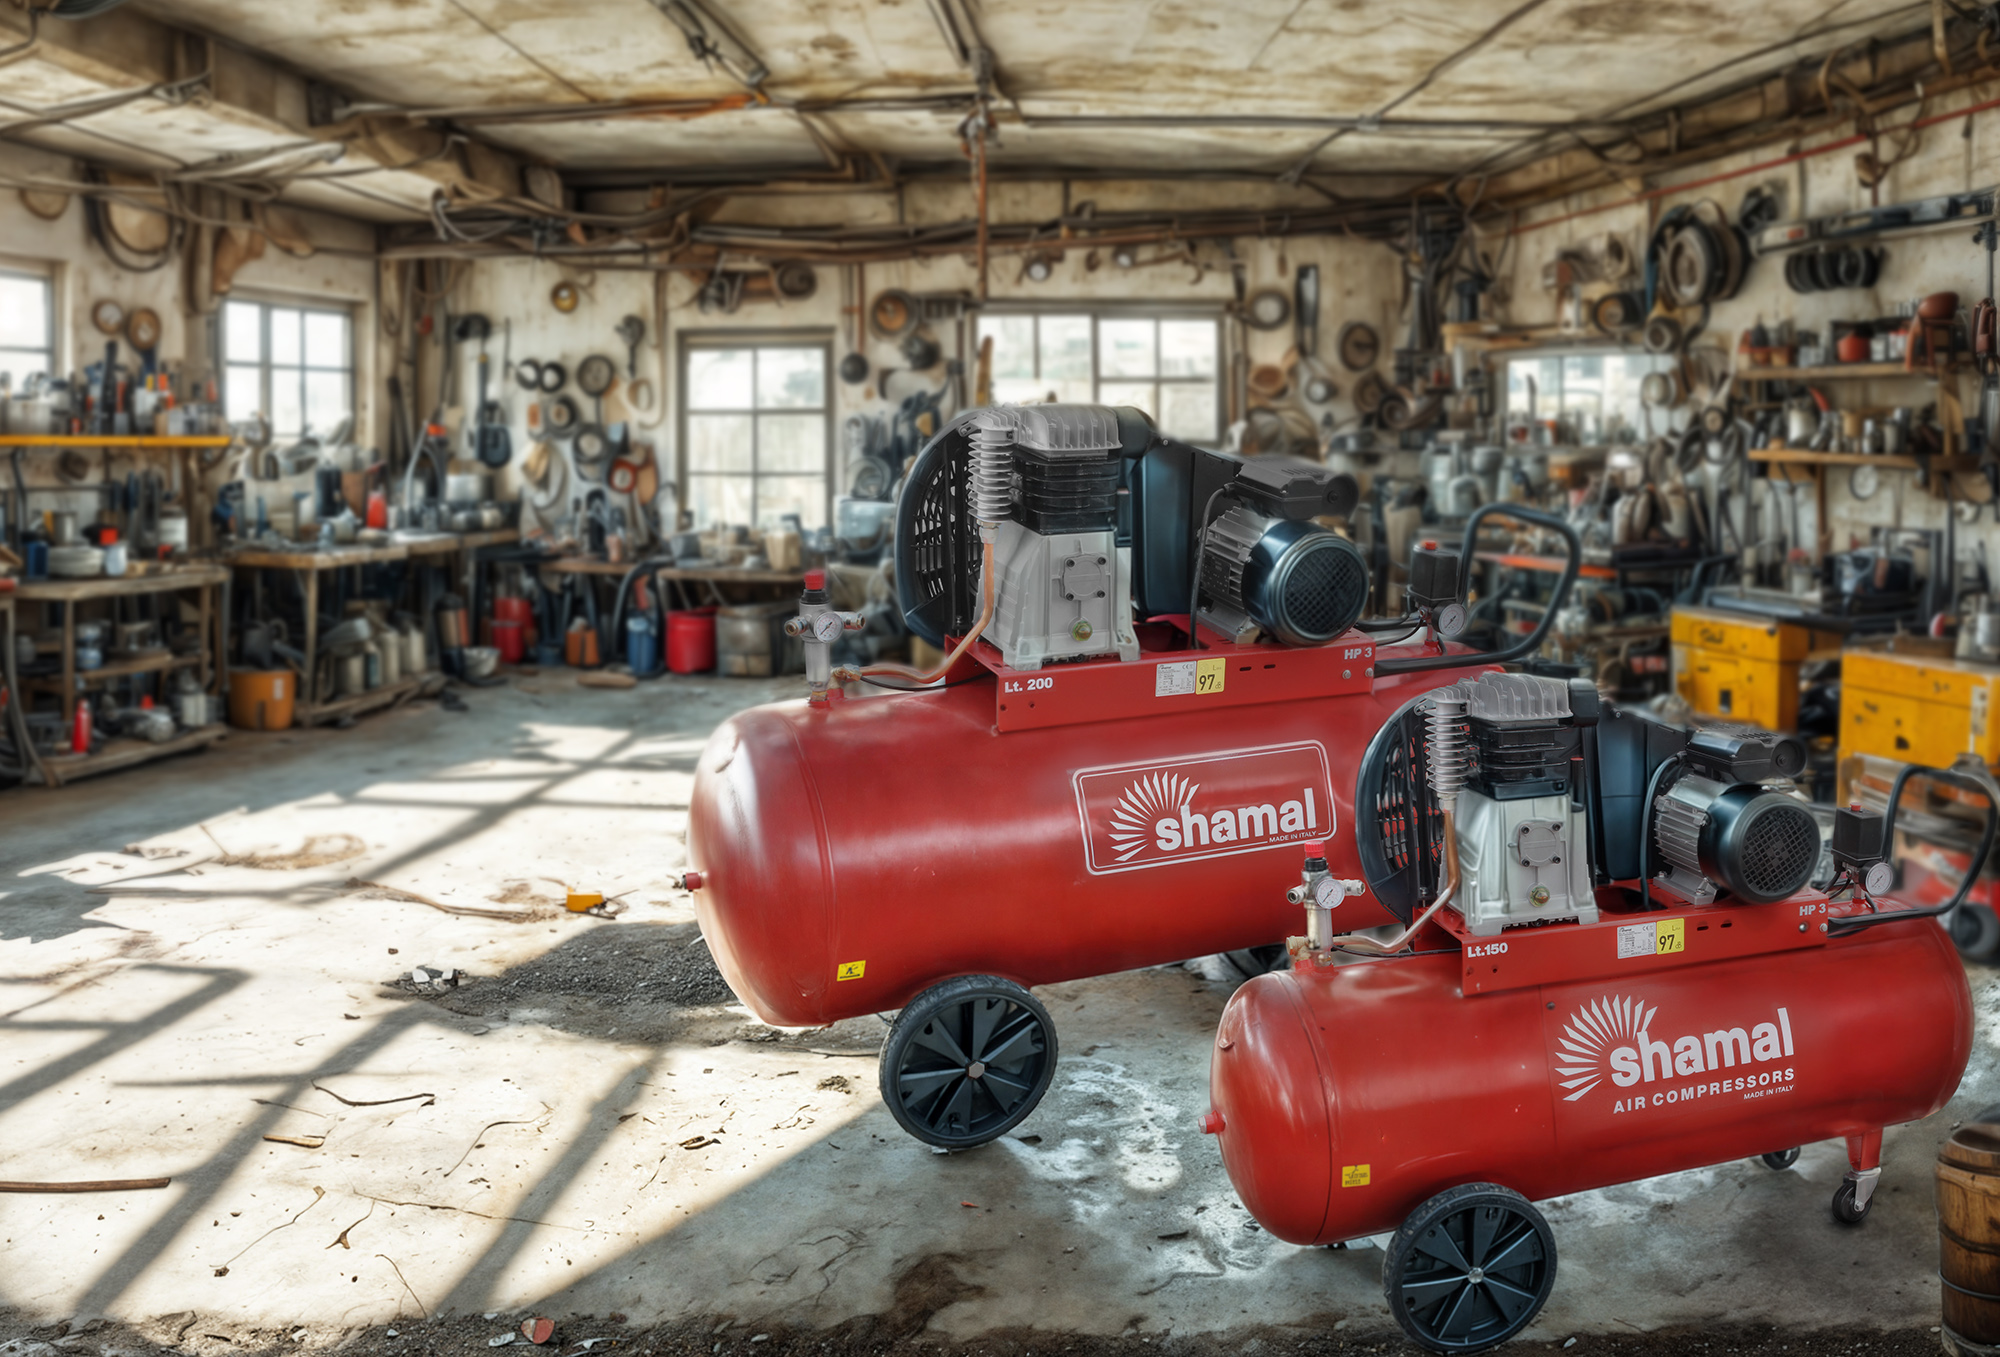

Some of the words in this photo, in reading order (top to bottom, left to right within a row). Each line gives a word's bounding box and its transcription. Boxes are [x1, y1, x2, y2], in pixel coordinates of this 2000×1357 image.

[1344, 648, 1362, 660] HP
[1364, 646, 1372, 658] 3
[1004, 681, 1023, 693] Lt.
[1026, 677, 1053, 691] 200
[1199, 674, 1216, 691] 97
[1155, 787, 1317, 851] shamal
[1269, 834, 1290, 843] MADE
[1299, 830, 1317, 839] ITALY
[1799, 904, 1816, 916] HP
[1818, 903, 1827, 914] 3
[1467, 942, 1509, 958] Lt.150
[1659, 934, 1675, 952] 97
[1610, 1007, 1794, 1087] shamal
[1613, 1096, 1646, 1114] AIR
[1652, 1068, 1795, 1106] COMPRESSORS
[1743, 1090, 1765, 1100] MADE
[1775, 1084, 1795, 1094] ITALY
